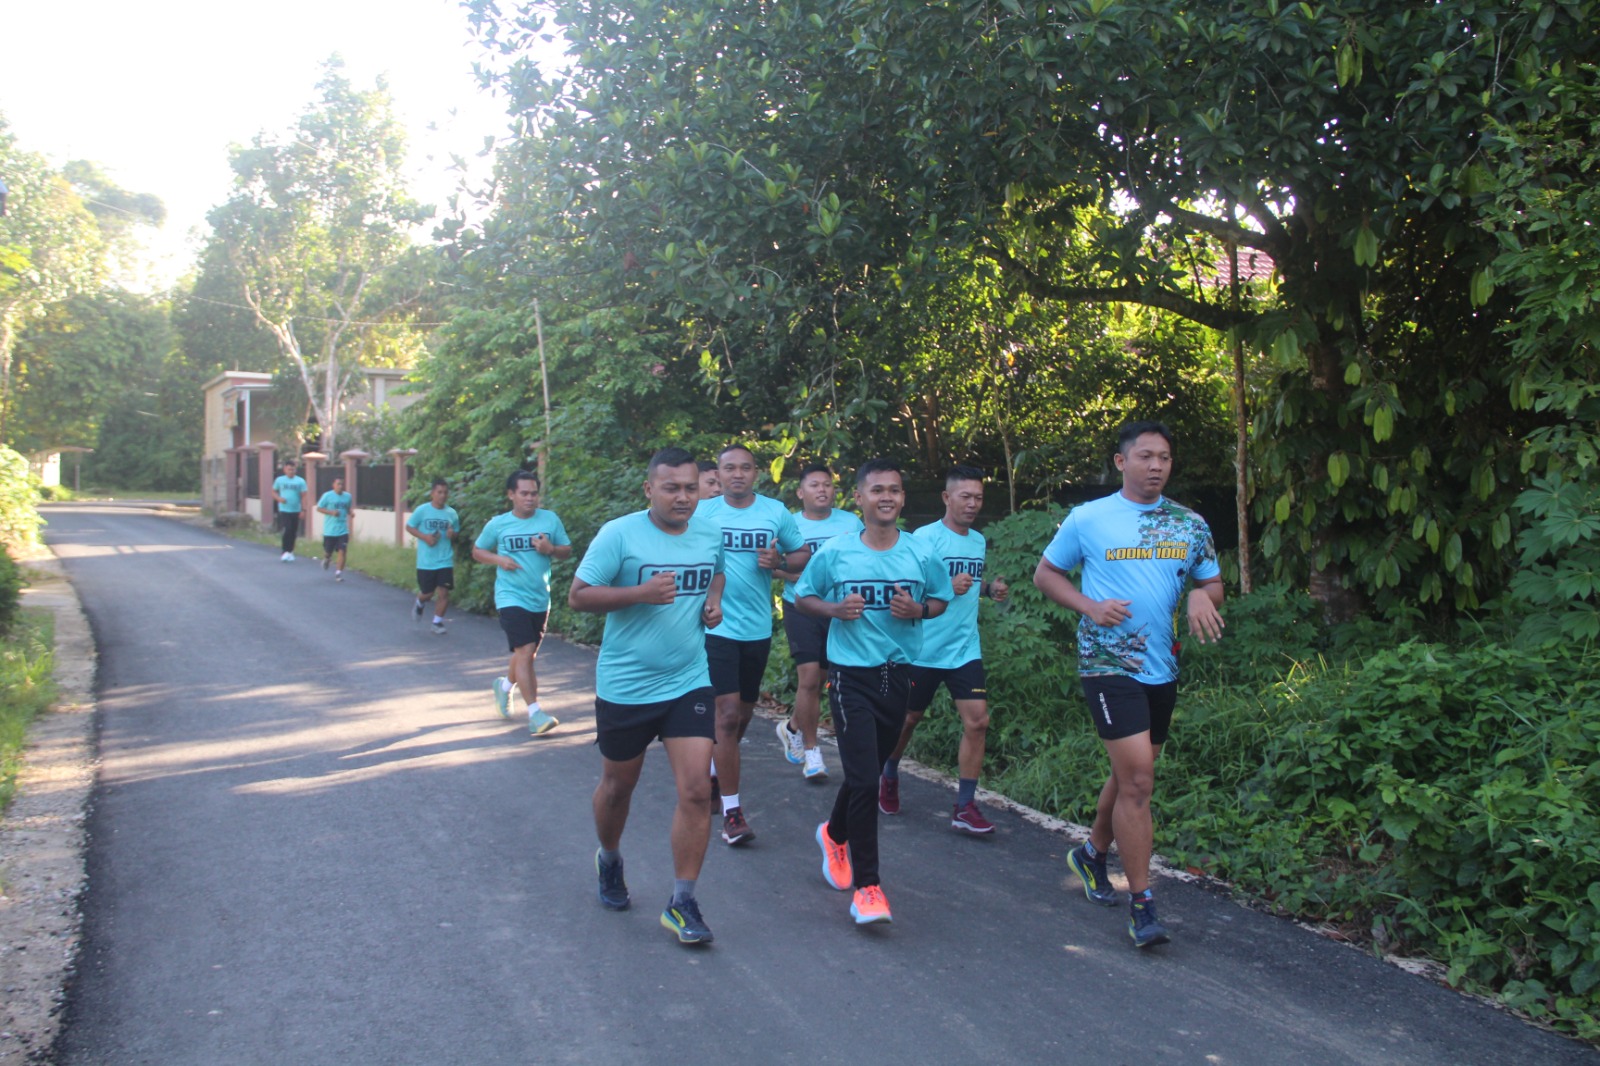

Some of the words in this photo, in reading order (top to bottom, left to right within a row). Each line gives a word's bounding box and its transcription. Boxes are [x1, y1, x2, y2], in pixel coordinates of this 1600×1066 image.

[1106, 548, 1153, 560] KODIM
[1155, 547, 1188, 560] 1008
[651, 569, 712, 591] :08
